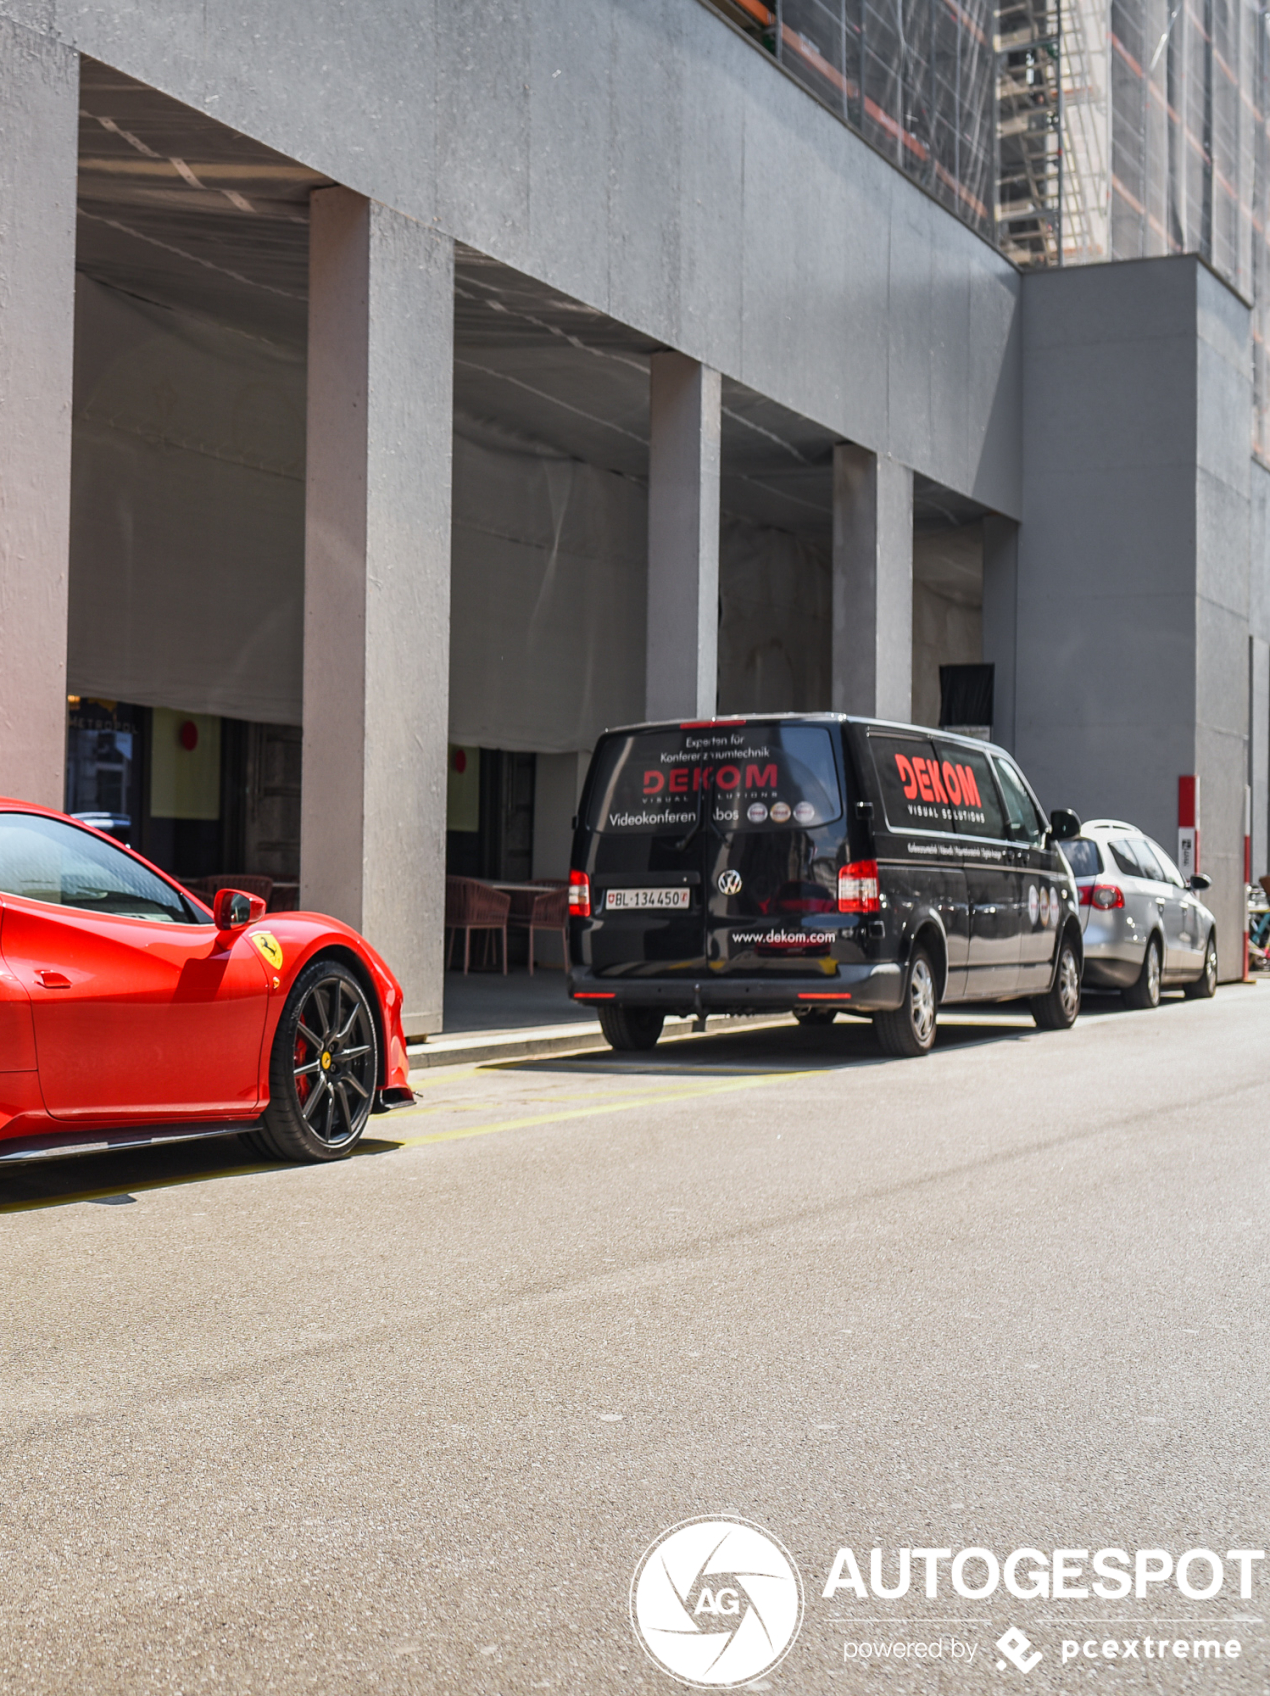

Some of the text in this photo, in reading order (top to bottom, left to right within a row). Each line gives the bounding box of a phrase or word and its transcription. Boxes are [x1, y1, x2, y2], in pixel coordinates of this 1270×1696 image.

[686, 733, 746, 750] Experten für
[642, 764, 778, 794] DEKOM
[894, 753, 982, 808] DEKOM
[642, 795, 689, 804] VISUAL
[701, 791, 778, 801] LUTIONS
[609, 809, 697, 827] Videokonferen
[907, 804, 986, 824] VISUAL SOLUTIONS
[732, 928, 836, 944] www.dekom.com
